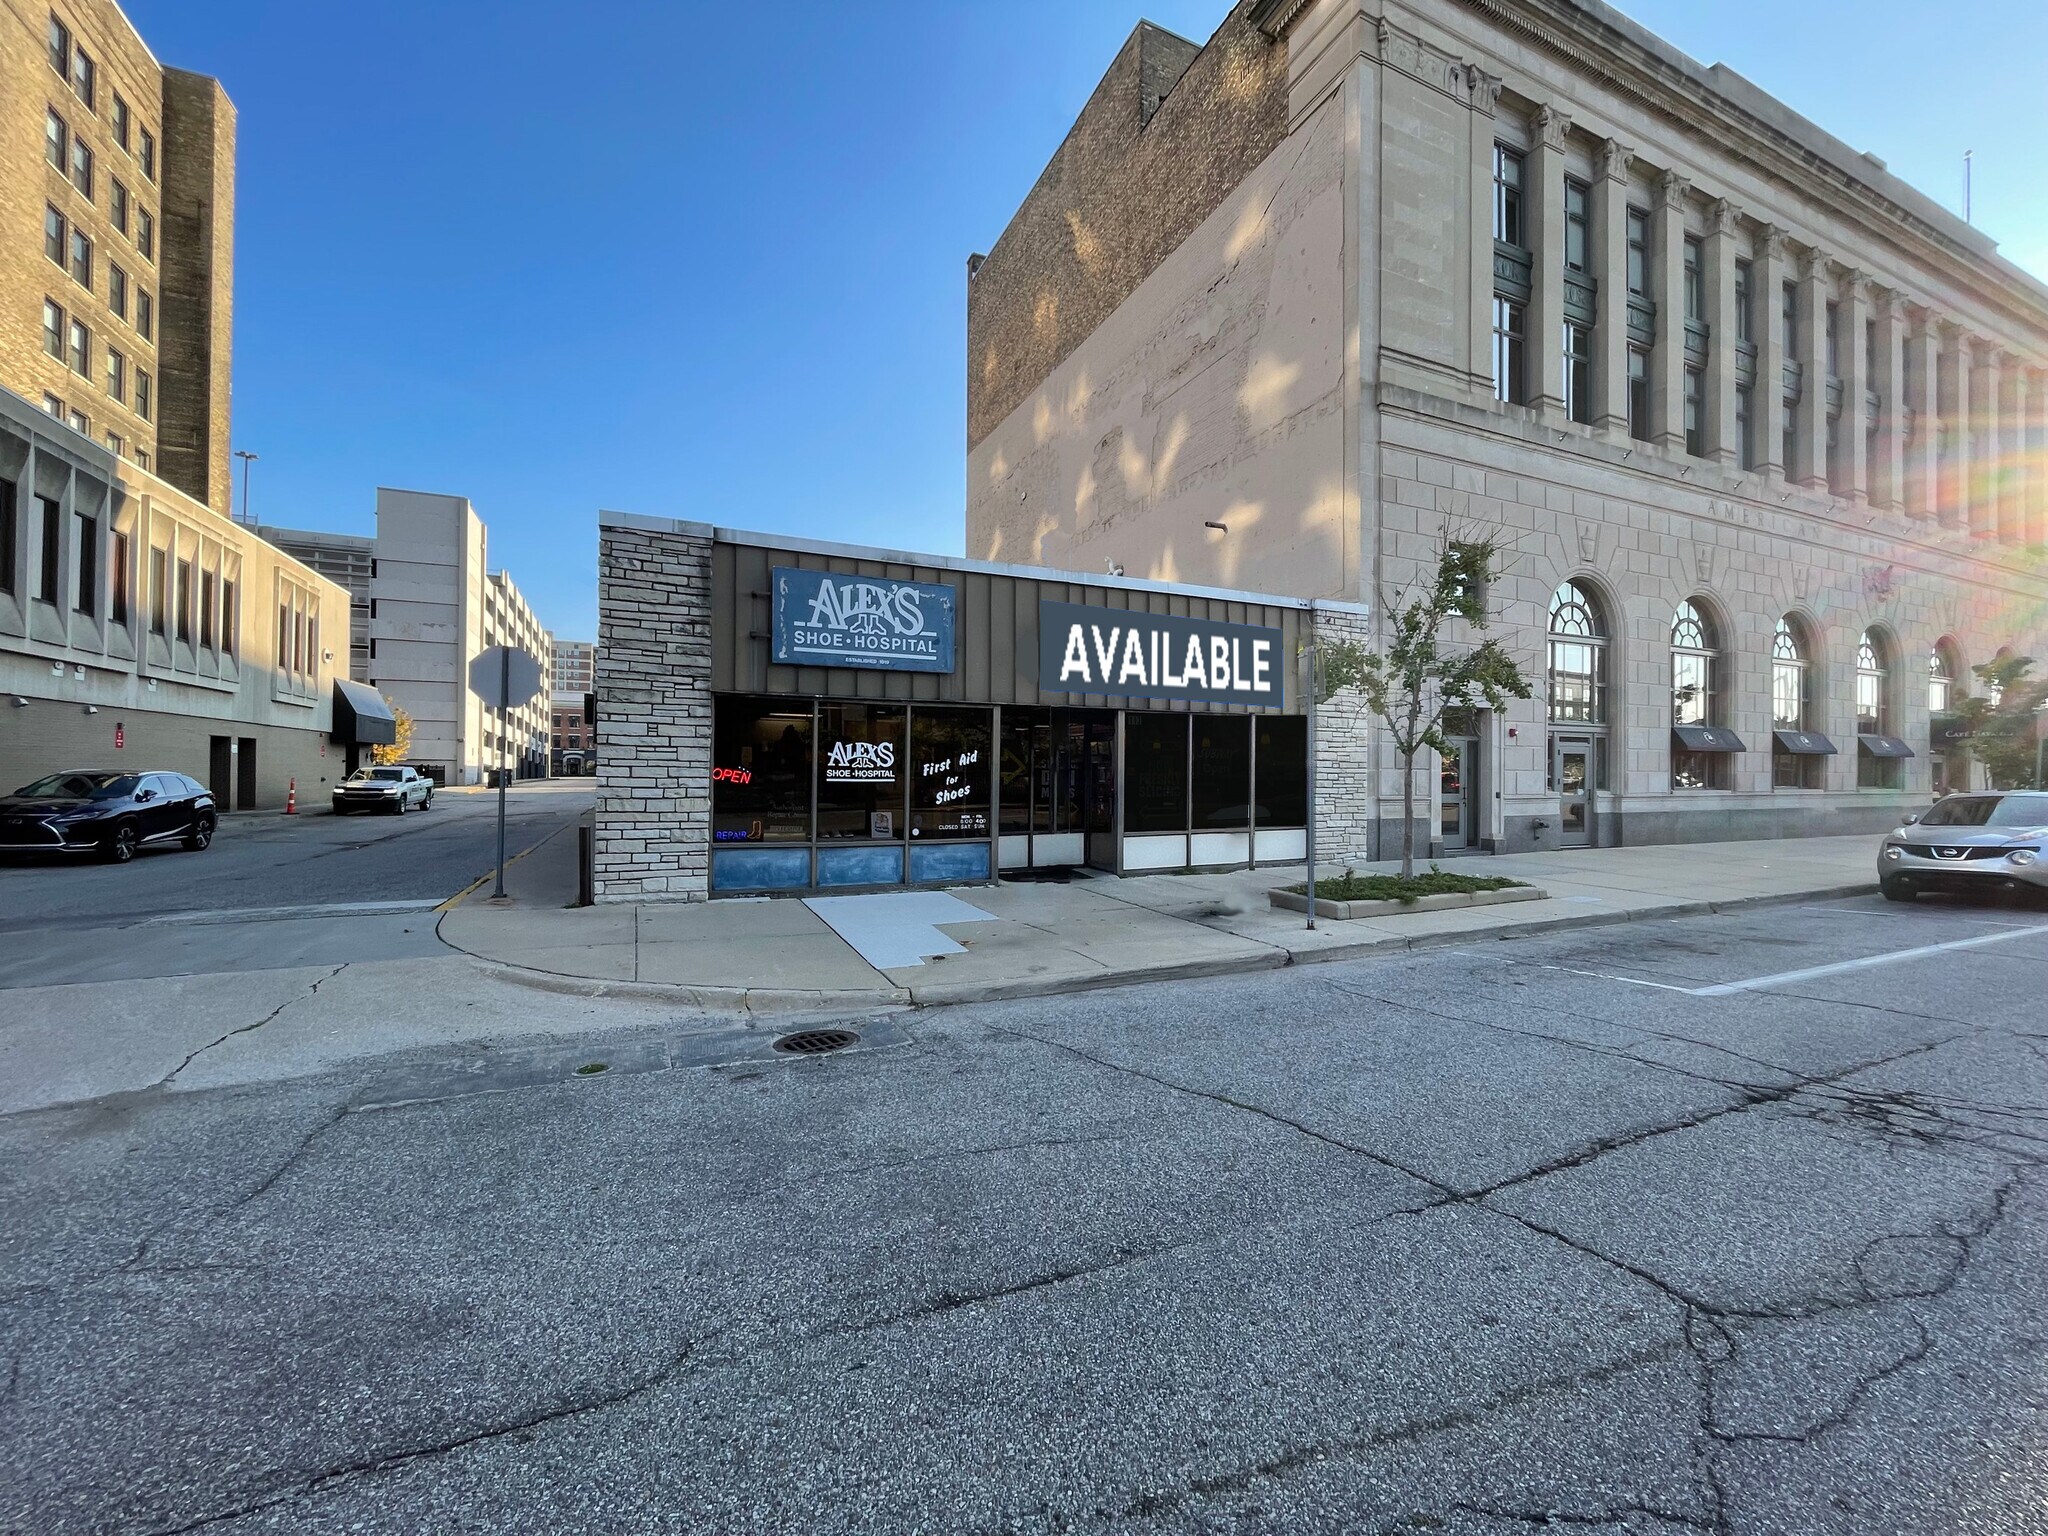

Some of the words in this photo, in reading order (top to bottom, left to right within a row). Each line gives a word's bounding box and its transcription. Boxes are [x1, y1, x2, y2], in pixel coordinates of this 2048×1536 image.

[1707, 500, 1820, 540] AMERICAN
[807, 578, 925, 636] ALEX'S
[794, 631, 843, 647] SHOE
[854, 635, 937, 653] HOSPITAL
[923, 758, 951, 777] First
[959, 749, 978, 766] Aid
[712, 767, 752, 784] OPEN
[826, 769, 851, 777] SHOE
[854, 769, 896, 778] HOSPITAL
[946, 776, 959, 786] for
[936, 785, 971, 805] Shoes
[716, 830, 747, 840] REPAIR
